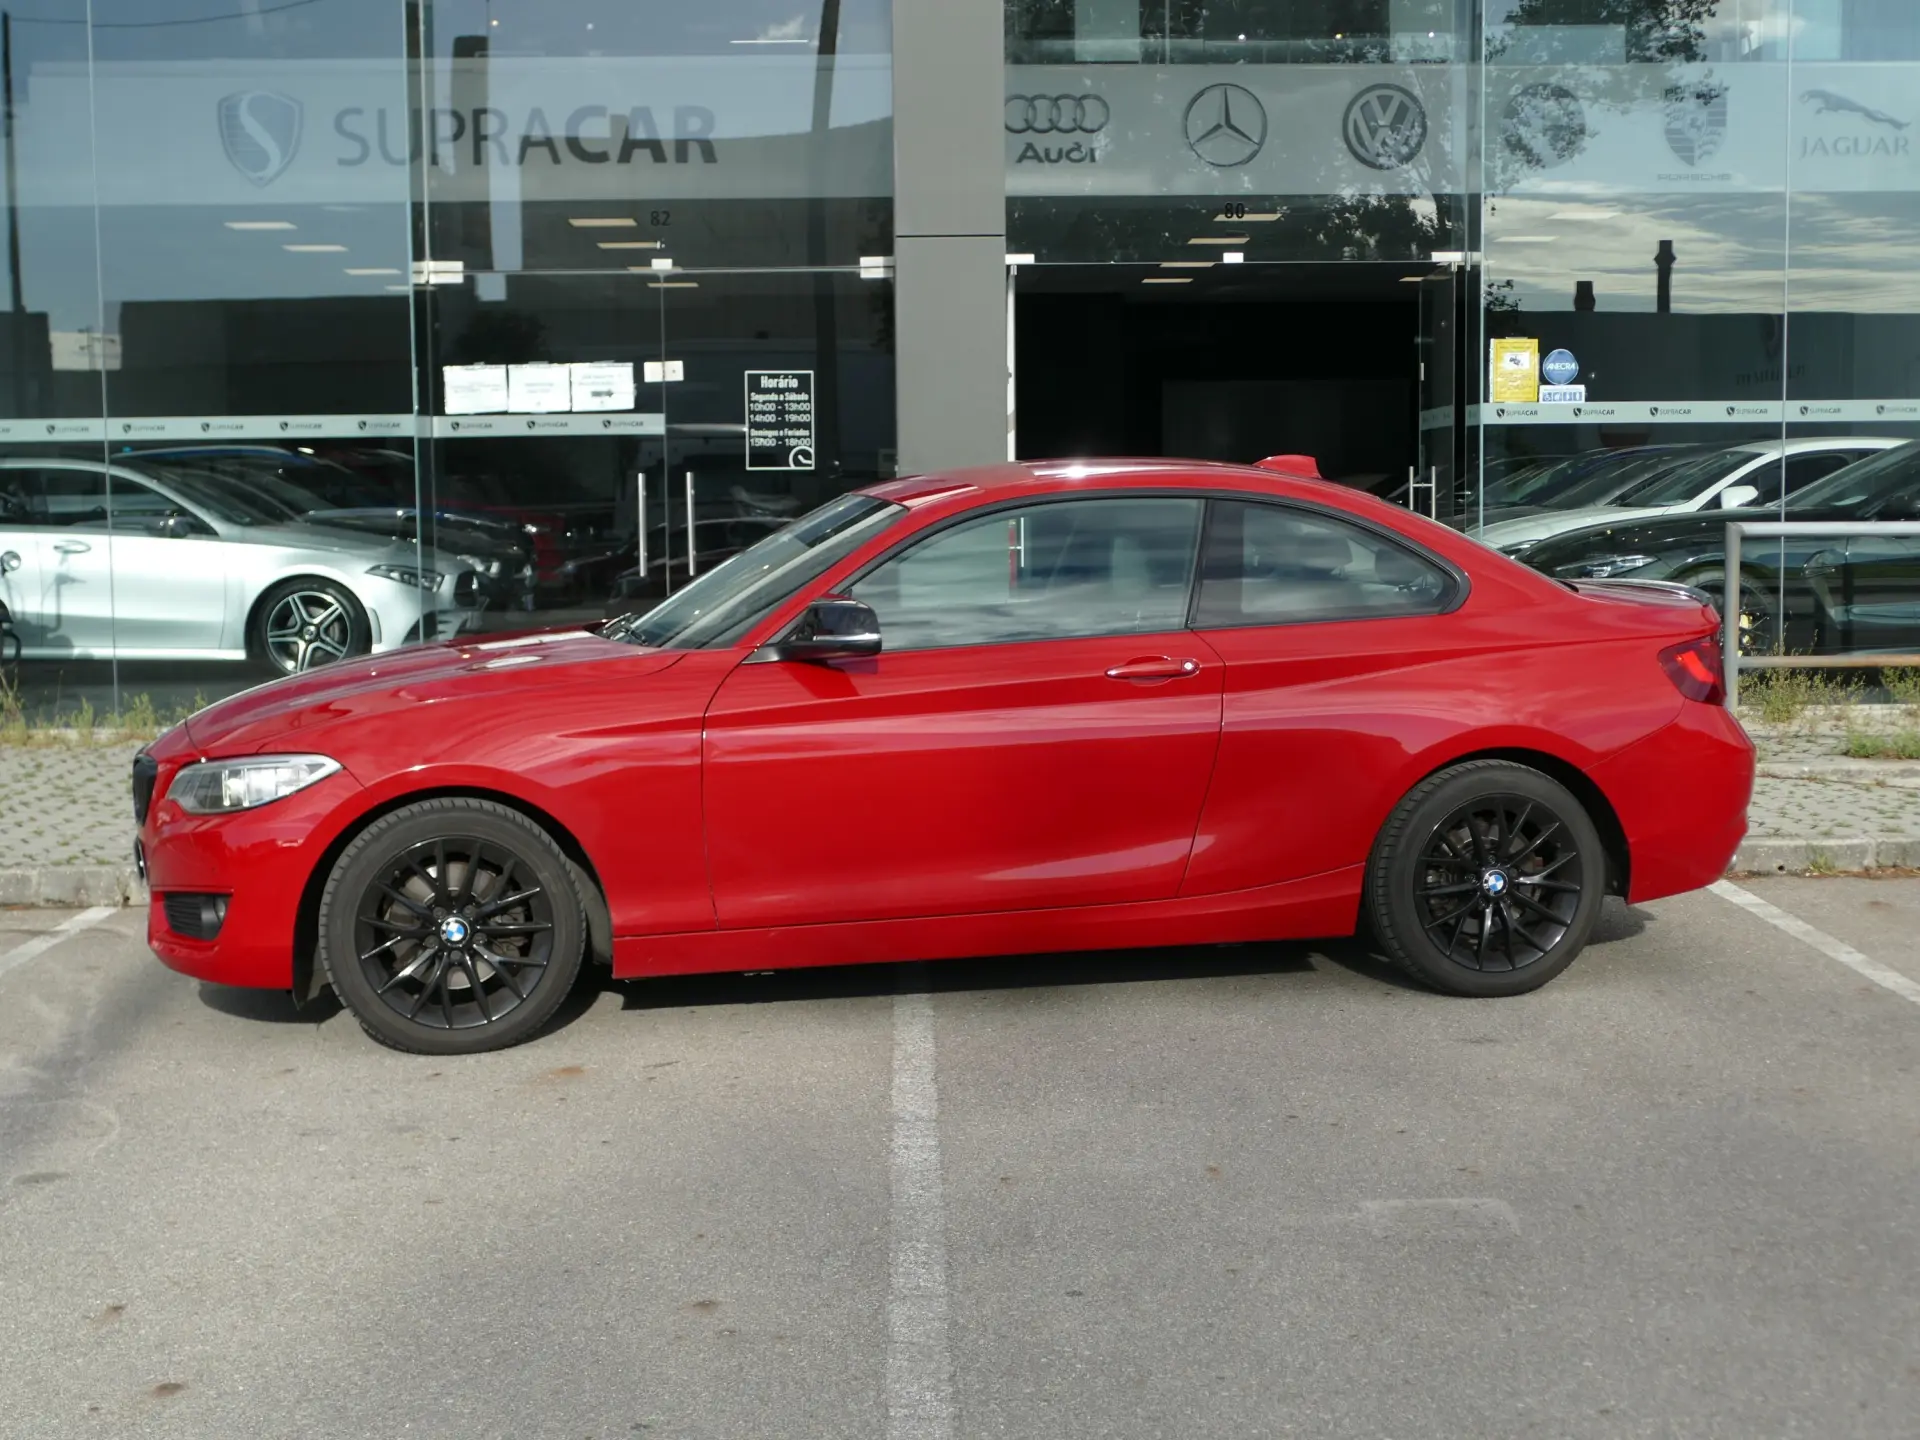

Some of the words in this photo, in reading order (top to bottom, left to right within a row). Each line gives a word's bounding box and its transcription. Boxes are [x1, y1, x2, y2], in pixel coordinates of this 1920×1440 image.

[334, 104, 718, 166] SUPRACAR
[1801, 135, 1911, 158] JAGUAR
[1015, 142, 1099, 164] Audi
[1225, 202, 1245, 219] 80
[650, 210, 671, 227] 82
[1546, 362, 1576, 371] ANECRA
[761, 375, 798, 388] Horário
[750, 403, 776, 411] 10h00
[784, 403, 811, 411] 13h00
[1735, 407, 1768, 415] SUPRACAR
[1505, 409, 1538, 417] SUPRACAR
[1582, 408, 1615, 416] SUPRACAR
[750, 414, 776, 422] 14h00
[750, 438, 777, 447] 15h00
